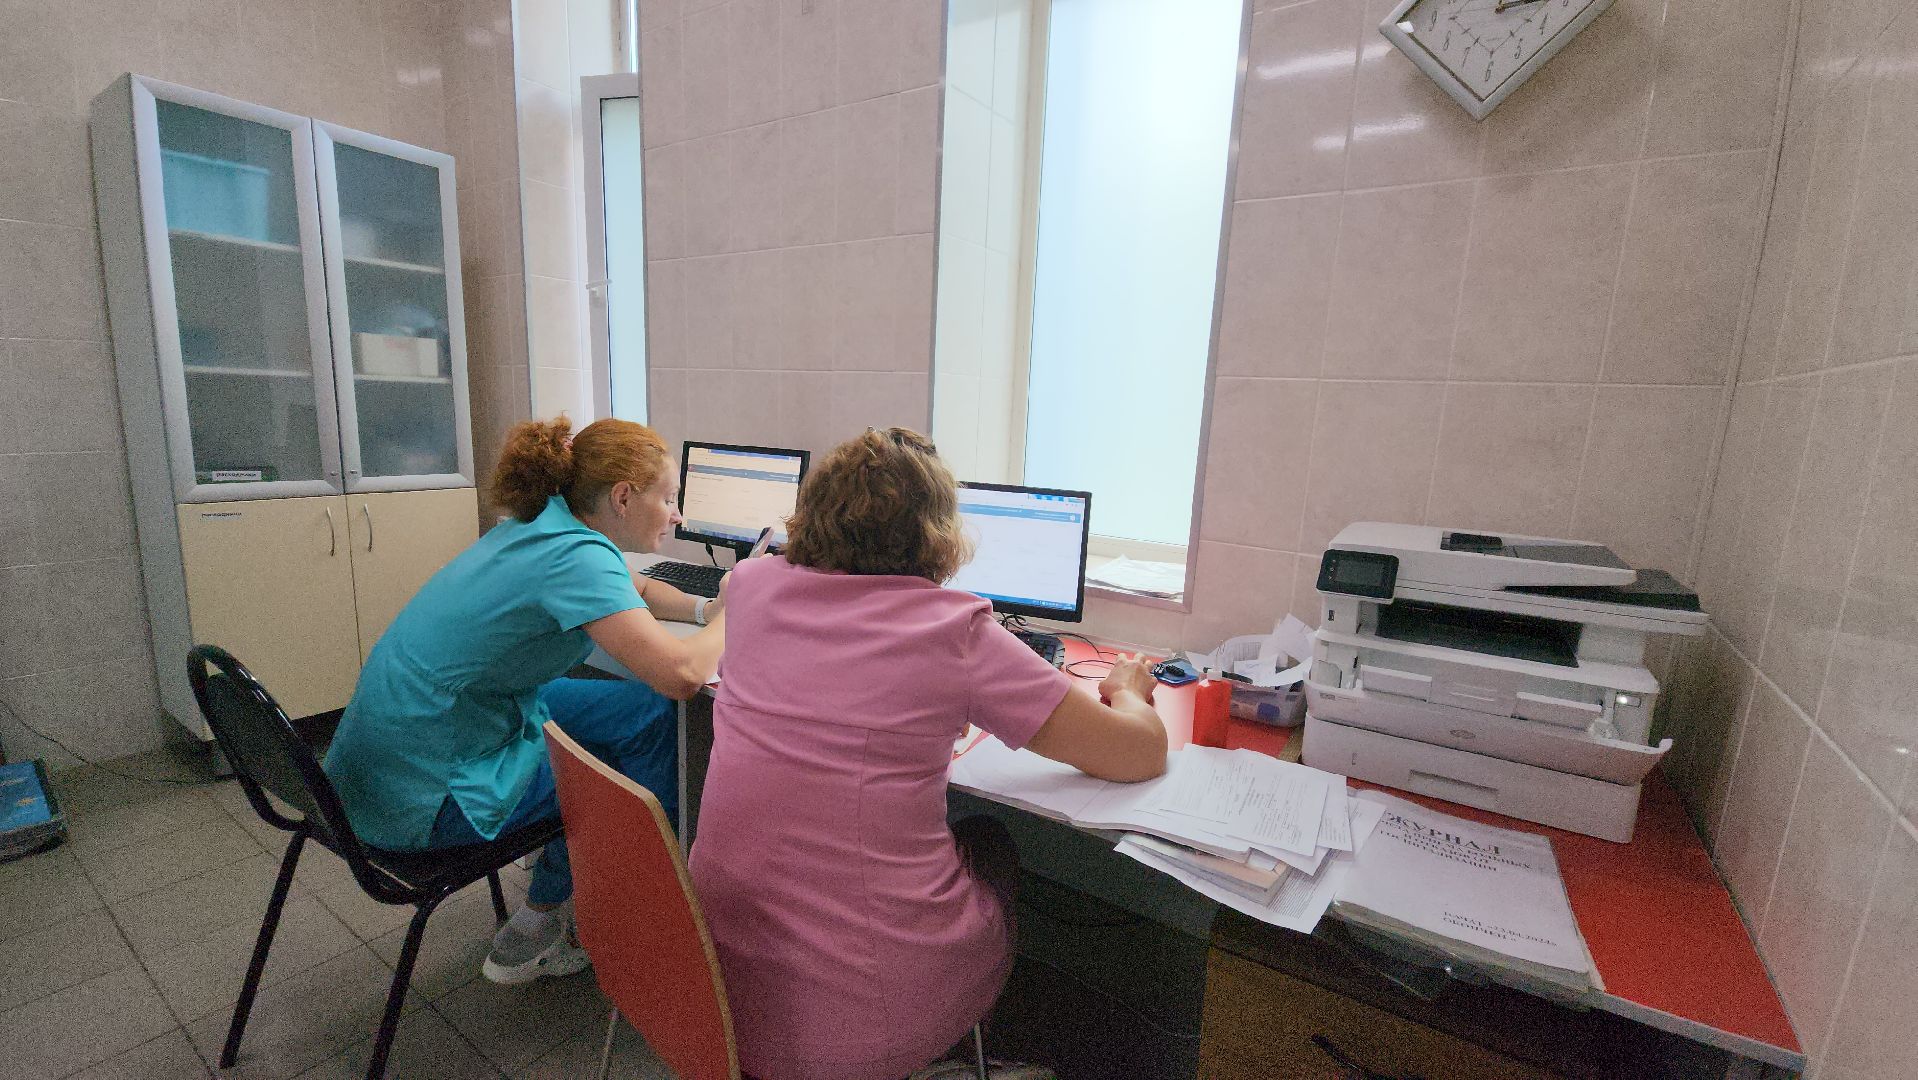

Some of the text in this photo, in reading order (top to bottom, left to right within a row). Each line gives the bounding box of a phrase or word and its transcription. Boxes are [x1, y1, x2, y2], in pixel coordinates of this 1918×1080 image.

[1429, 10, 1438, 32] 9
[1443, 30, 1452, 51] 8
[1484, 60, 1494, 82] 6
[1386, 812, 1499, 856] ЖУРНАЛ
